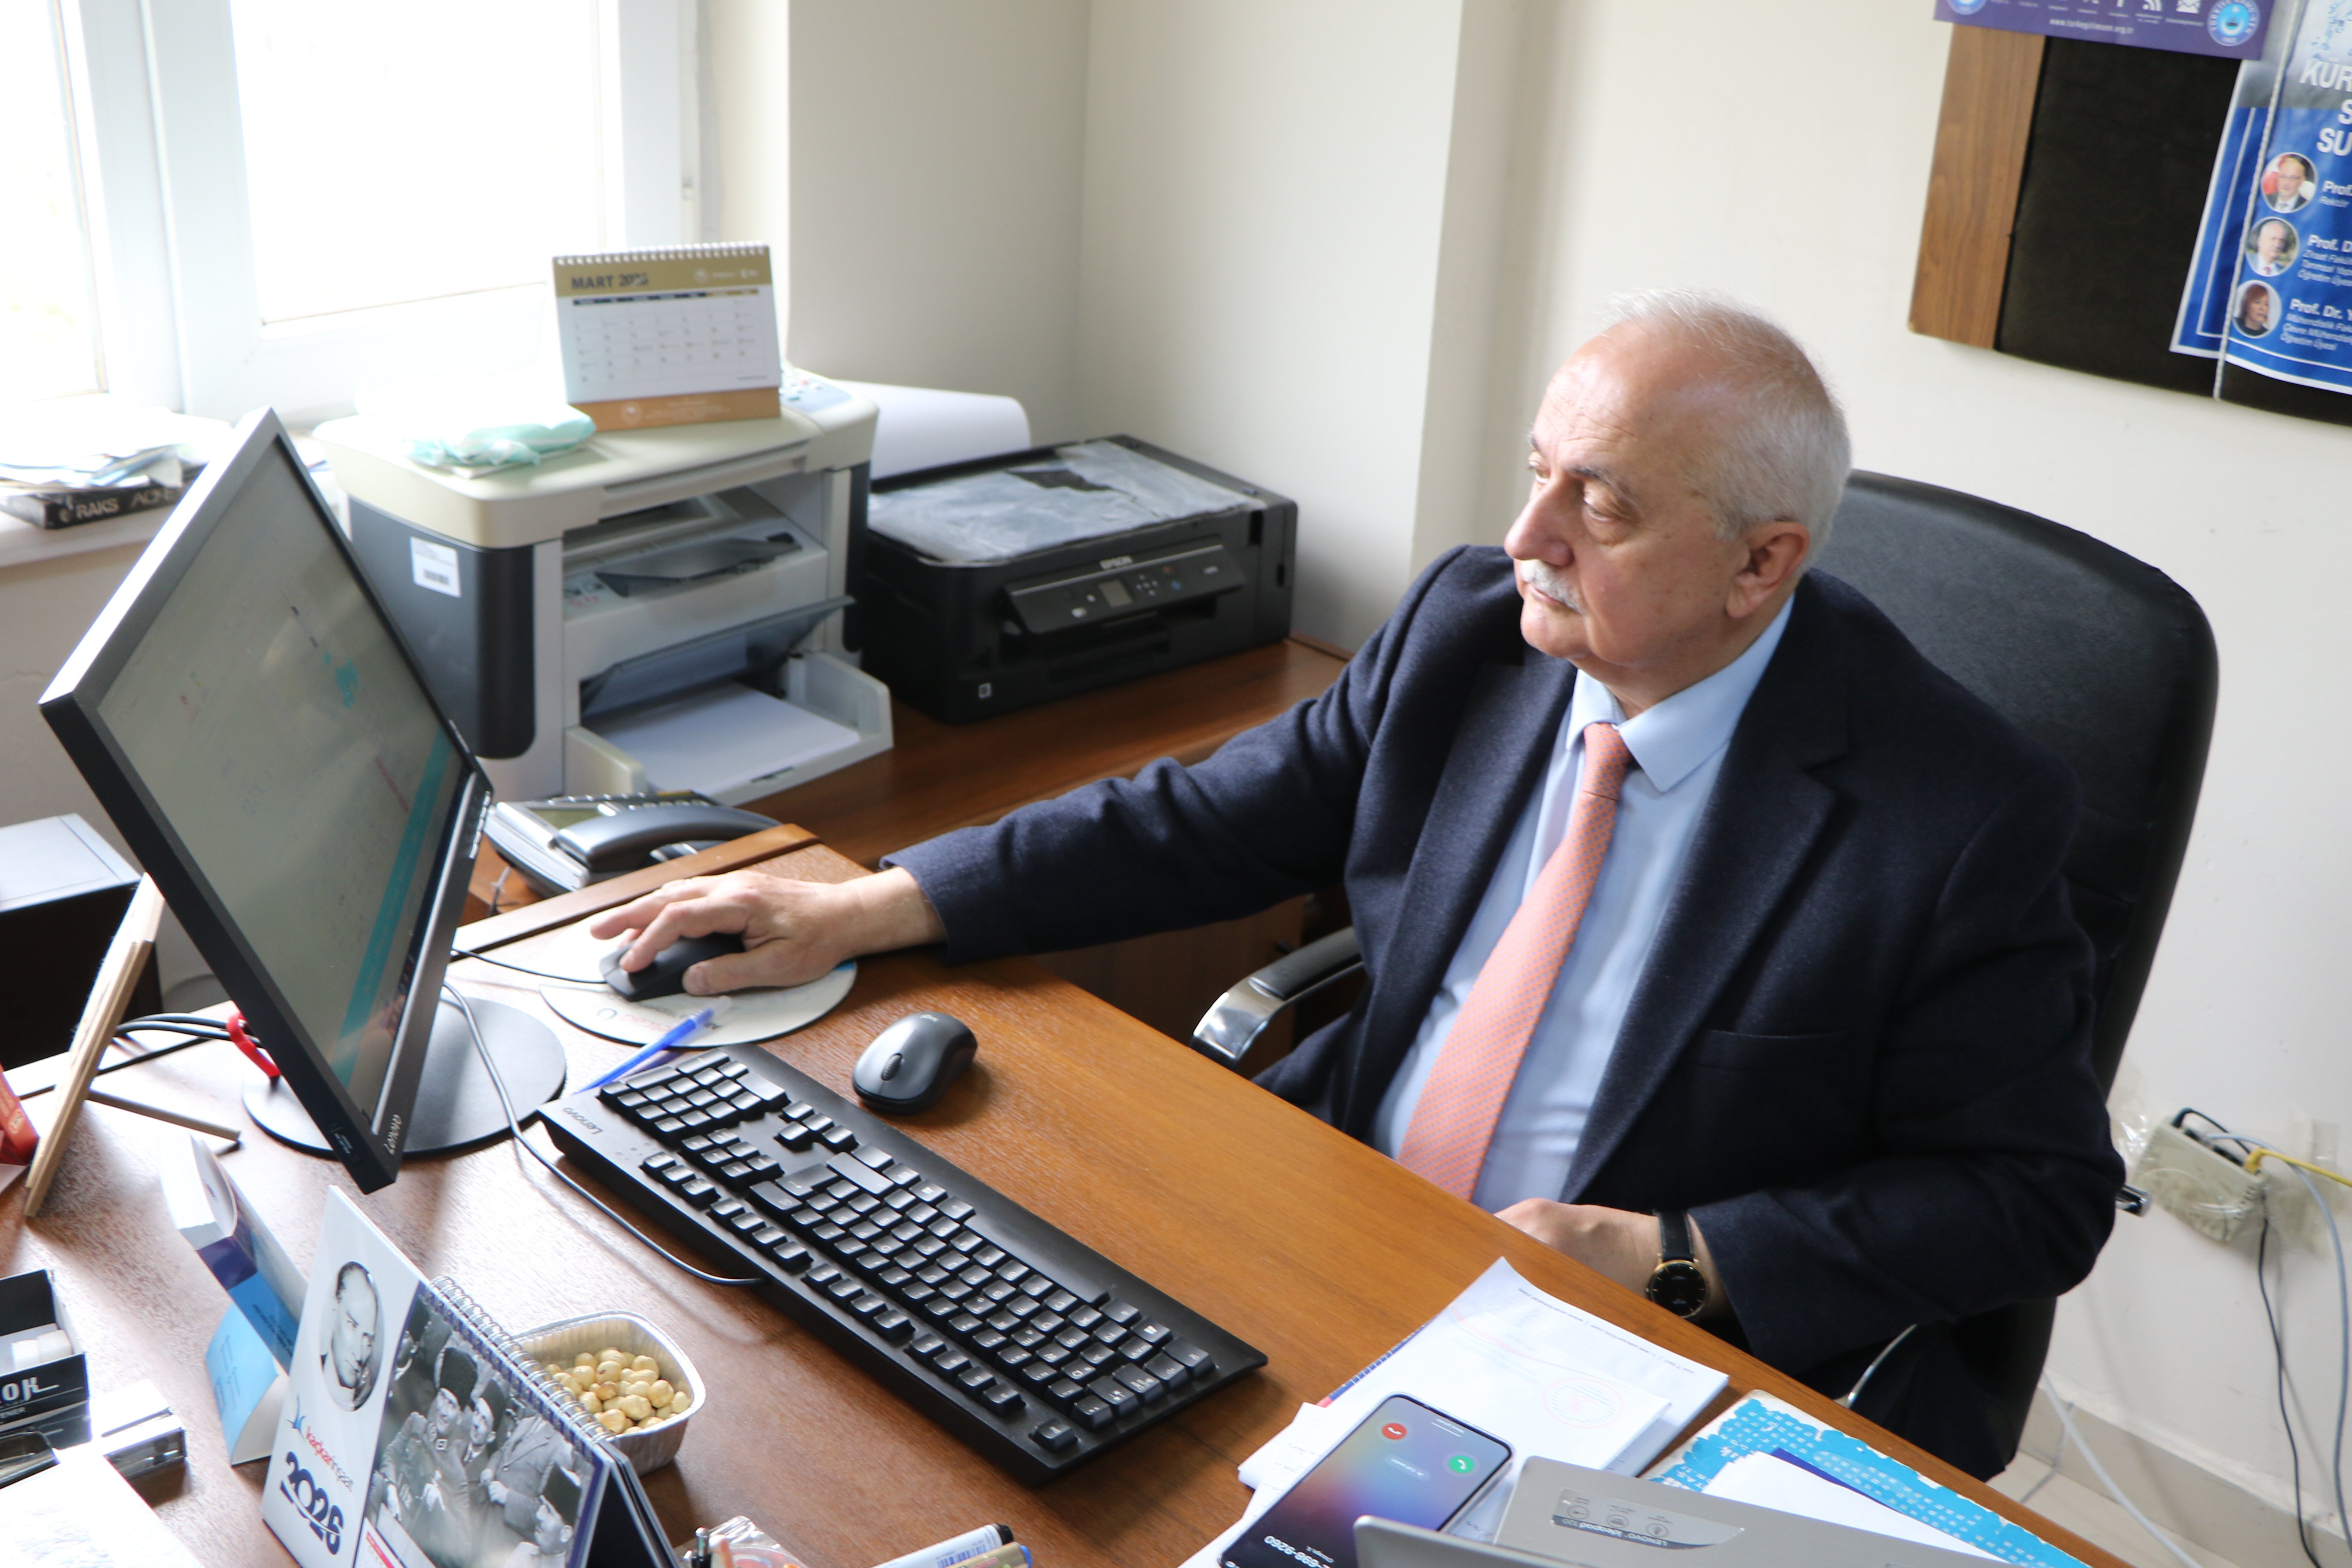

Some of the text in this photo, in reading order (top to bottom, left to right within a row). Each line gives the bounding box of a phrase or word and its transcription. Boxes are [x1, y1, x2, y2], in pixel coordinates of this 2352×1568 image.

[2307, 234, 2338, 251] Prof.
[571, 275, 612, 290] MART
[2290, 298, 2320, 315] Prof.
[2322, 305, 2343, 319] Dr.
[76, 498, 119, 519] RAKS
[563, 1106, 603, 1135] Lenovo
[280, 1451, 344, 1555] 2026
[1627, 1532, 1667, 1546] LENOVO
